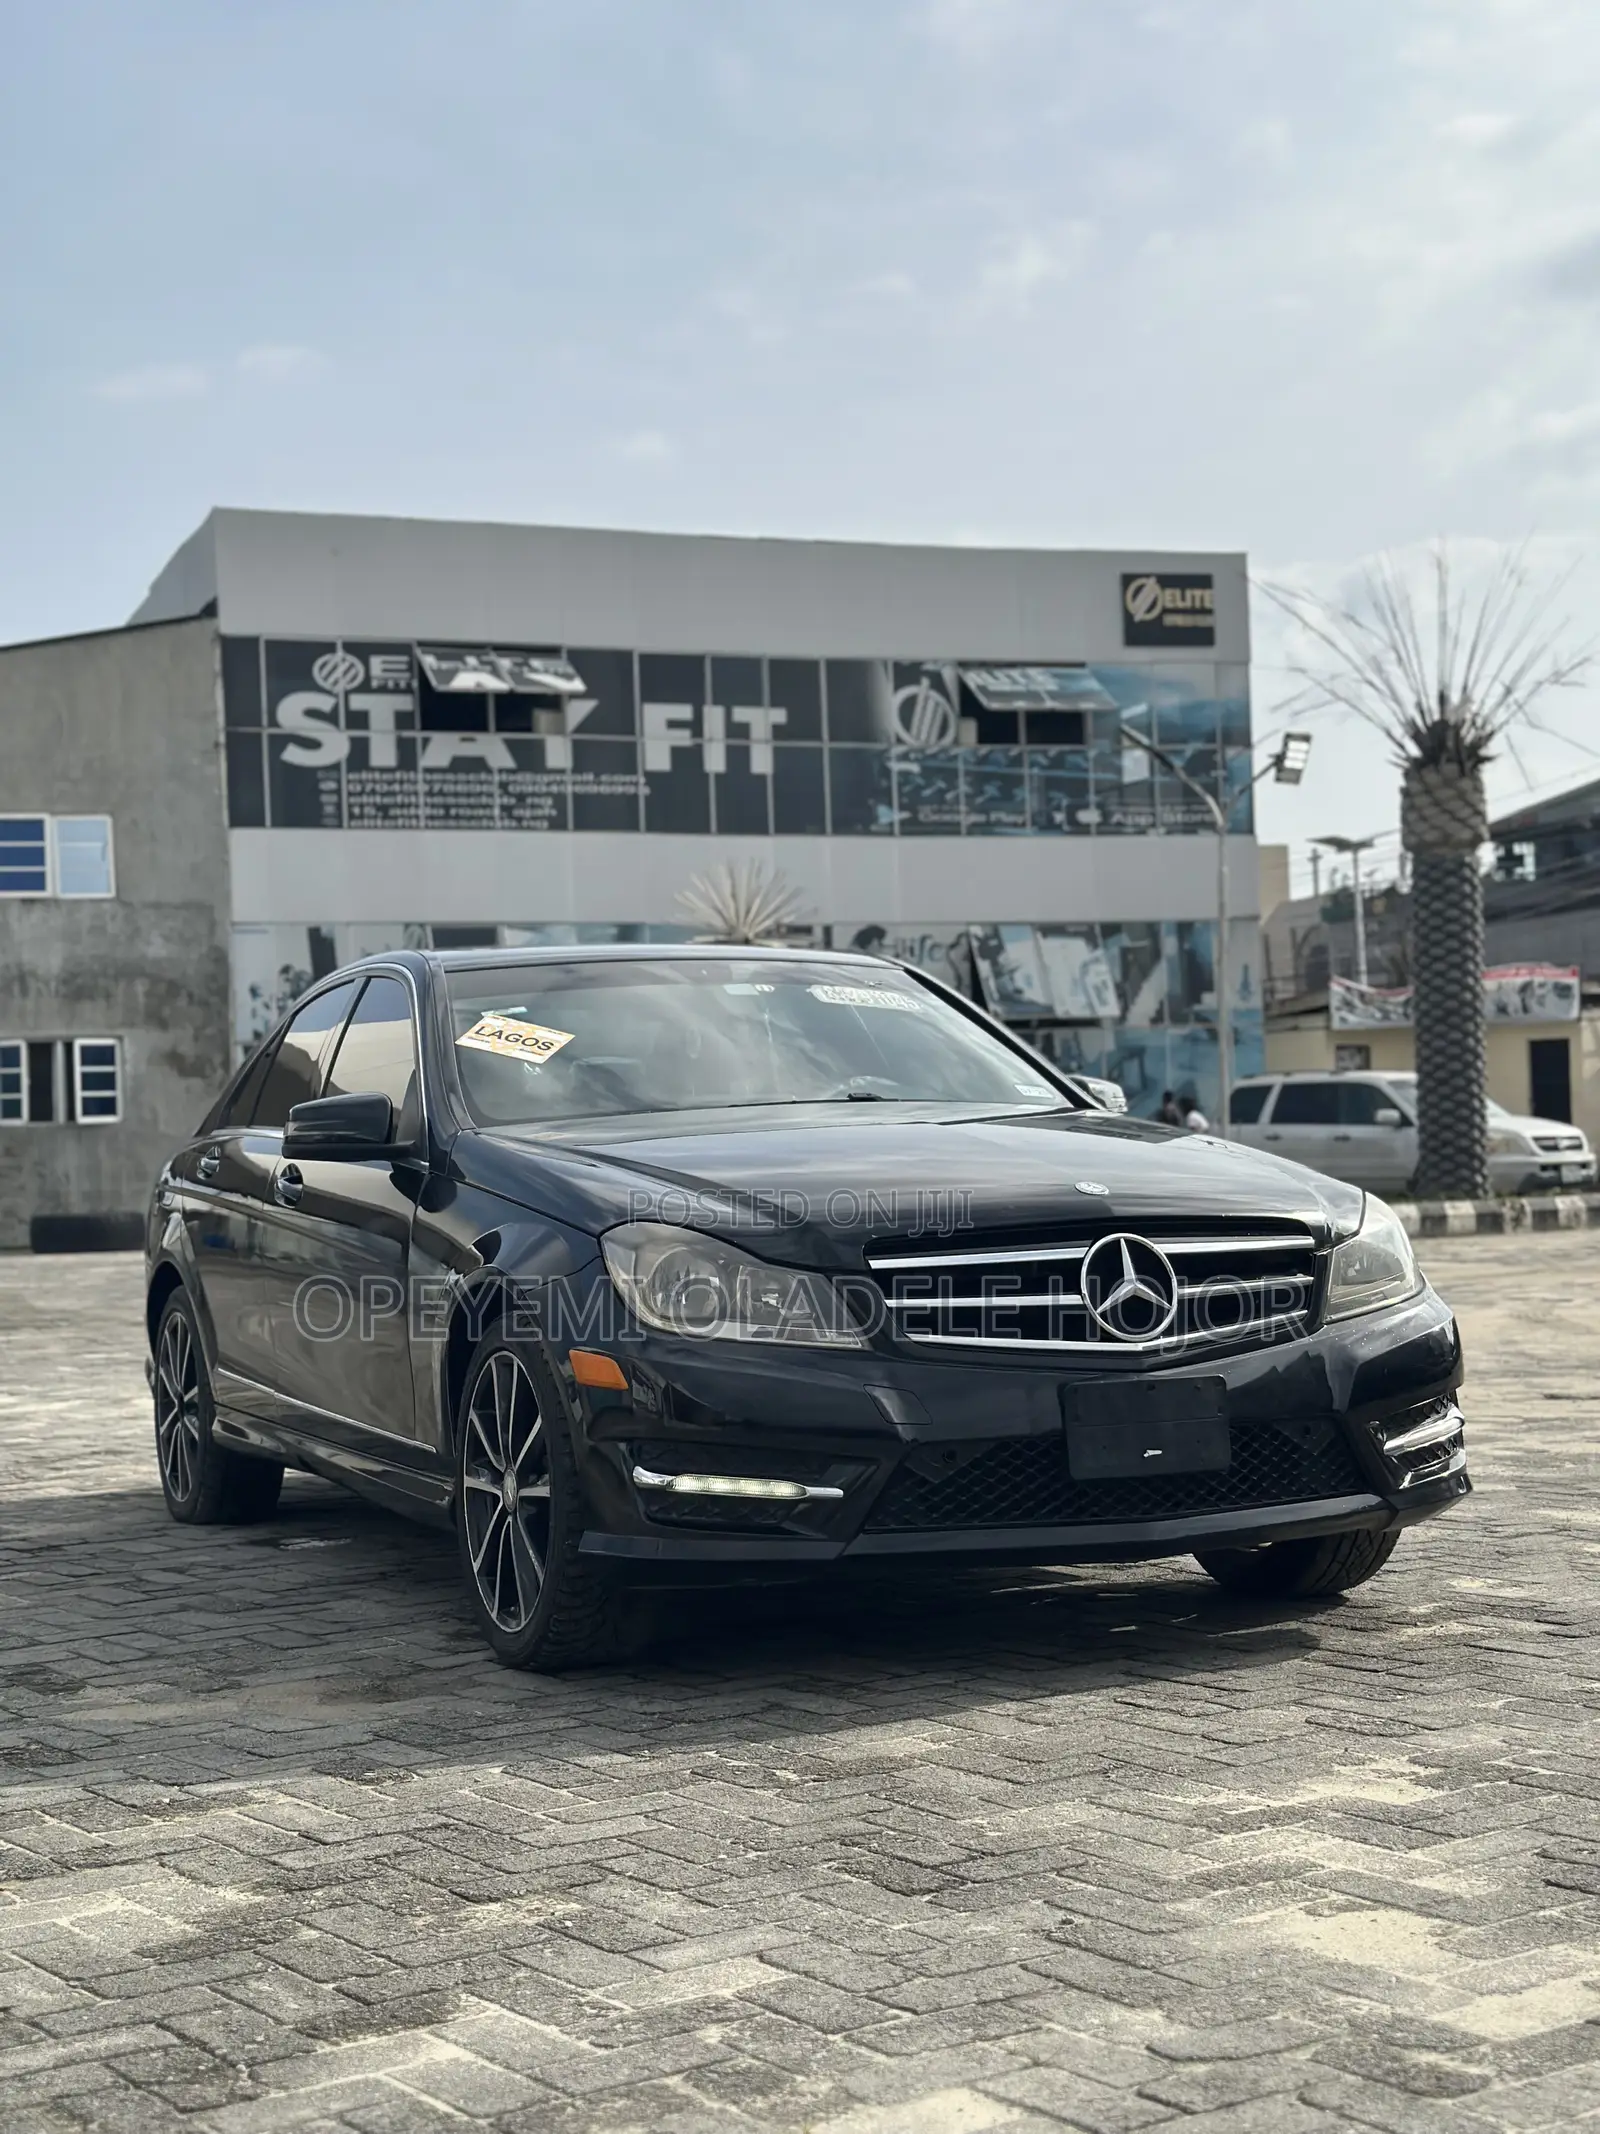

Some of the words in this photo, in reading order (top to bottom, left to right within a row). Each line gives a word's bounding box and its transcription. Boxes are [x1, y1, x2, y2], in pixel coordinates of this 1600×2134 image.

[1162, 588, 1213, 609] ELITE
[642, 703, 788, 774] FIT
[474, 1026, 555, 1051] LAGOS
